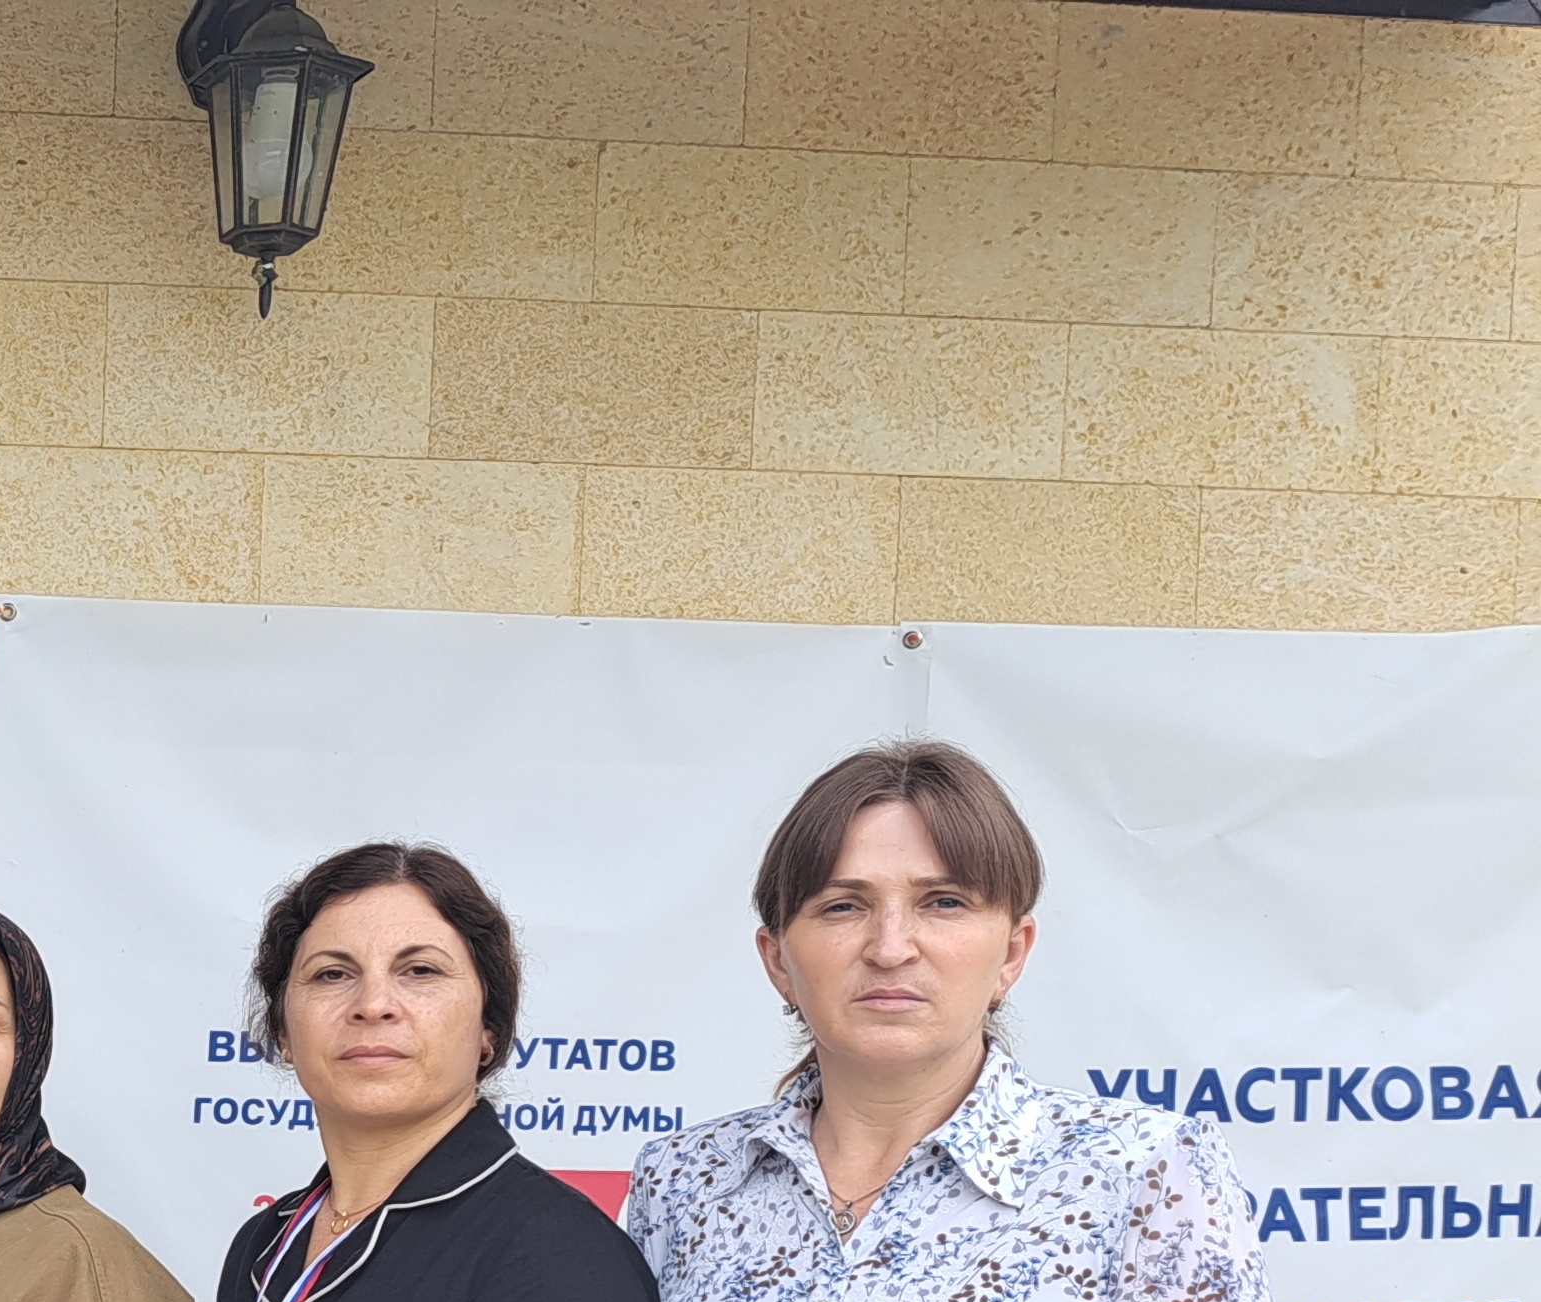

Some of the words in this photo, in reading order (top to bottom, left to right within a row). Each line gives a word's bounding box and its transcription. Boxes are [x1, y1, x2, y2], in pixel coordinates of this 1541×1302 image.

[207, 1030, 276, 1063] ВЫ
[514, 1037, 676, 1072] УТАТОВ
[572, 1105, 684, 1137] ДУМЫ
[1245, 1183, 1541, 1243] АТЕЛЬН
